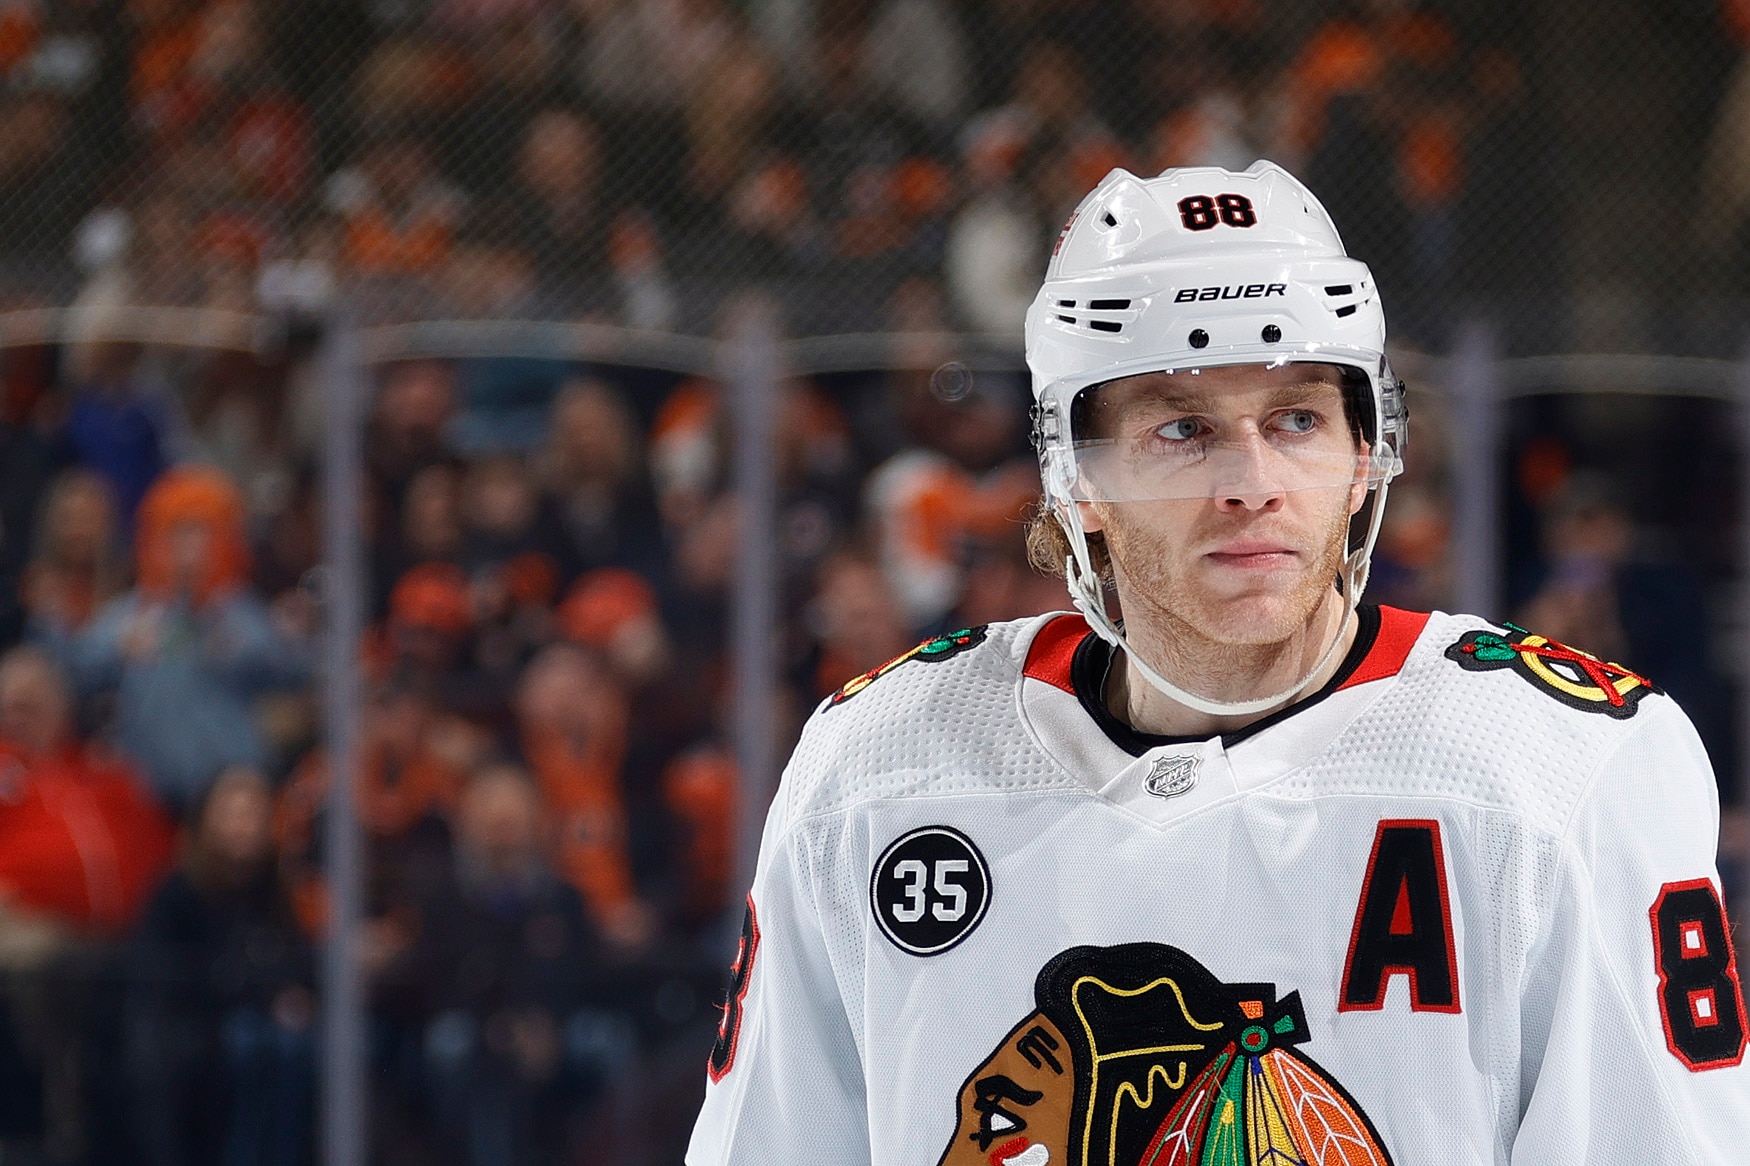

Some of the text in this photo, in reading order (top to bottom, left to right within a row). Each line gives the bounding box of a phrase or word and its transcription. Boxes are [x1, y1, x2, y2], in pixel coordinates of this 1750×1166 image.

[1176, 193, 1259, 233] 88
[891, 859, 969, 923] 35
[1337, 818, 1462, 1014] A
